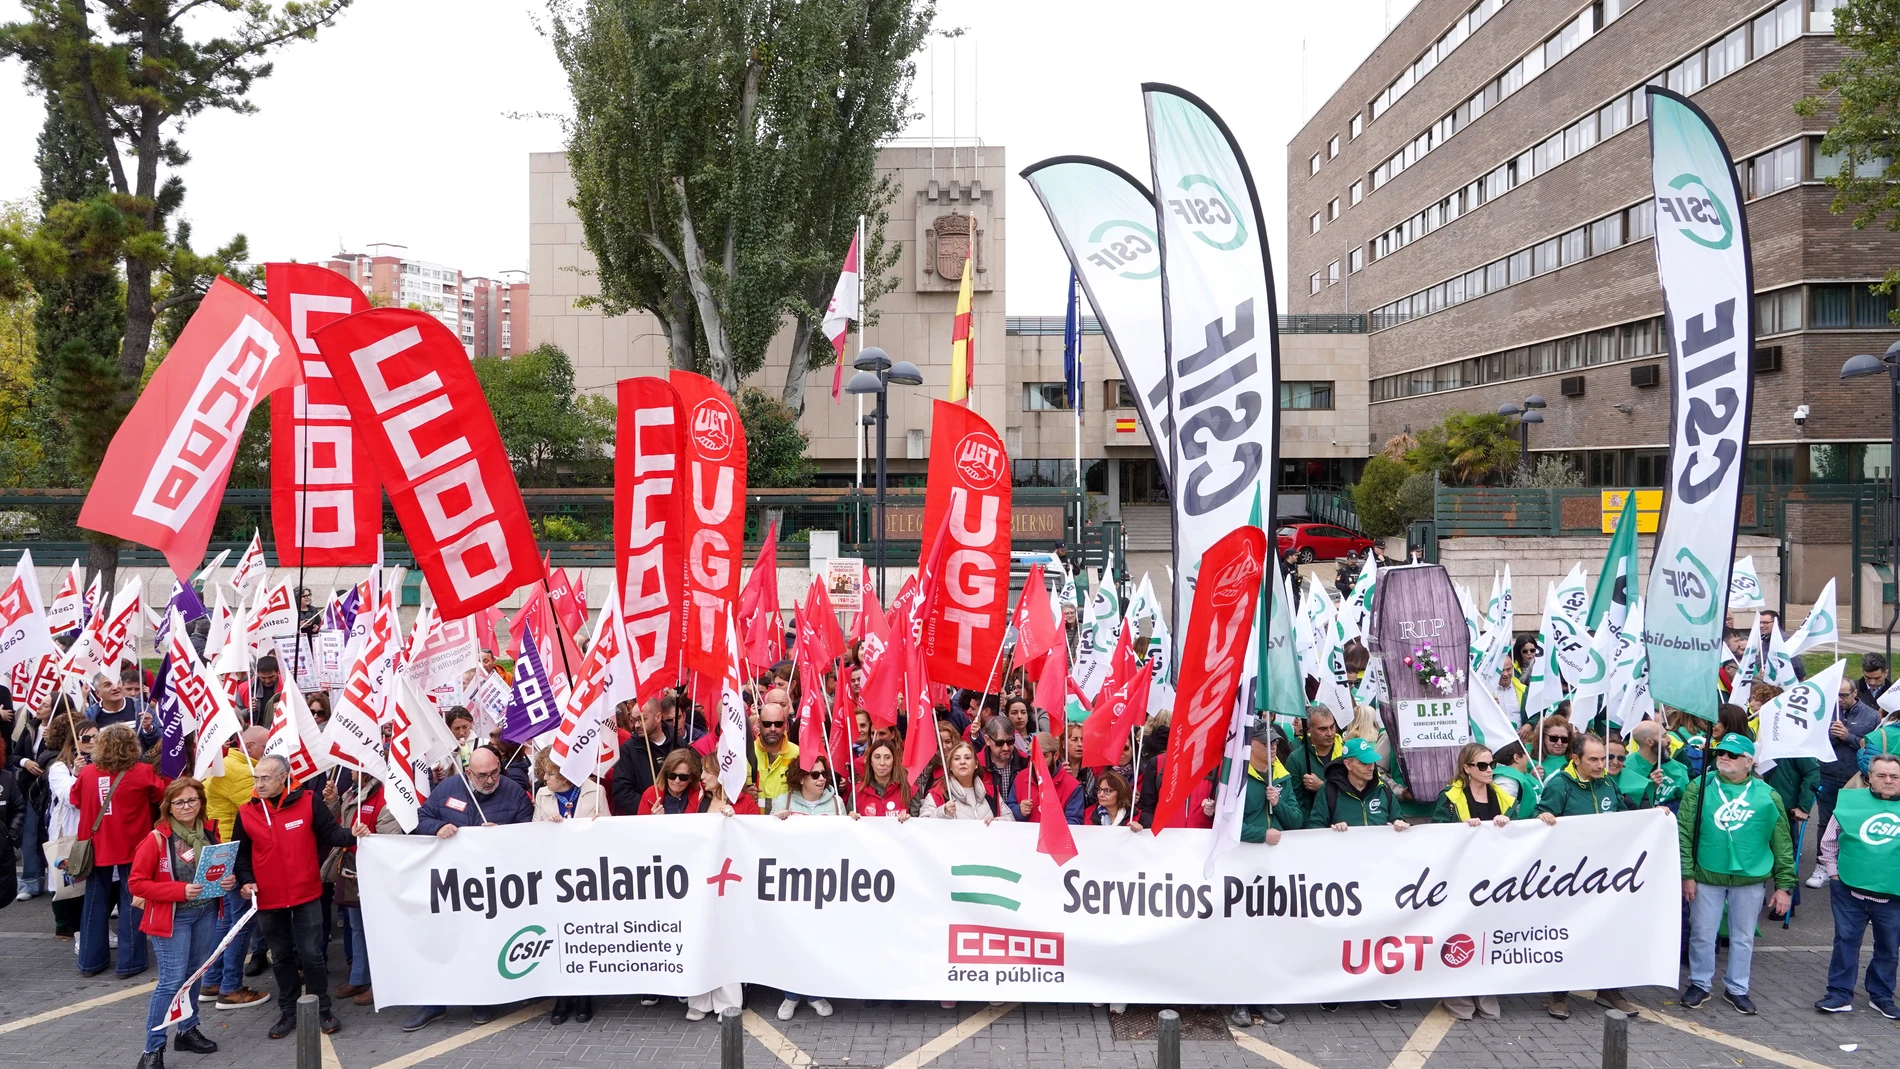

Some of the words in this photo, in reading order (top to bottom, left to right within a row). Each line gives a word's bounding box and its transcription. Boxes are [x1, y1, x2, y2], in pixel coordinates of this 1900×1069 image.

[695, 406, 728, 434] UGT
[350, 325, 513, 602] CCOO
[961, 439, 999, 470] UGT
[623, 406, 675, 685] CCOO
[690, 461, 735, 653] UGT
[943, 487, 999, 667] UGT
[926, 617, 936, 656] Castilla
[1399, 618, 1445, 640] RIP
[1184, 591, 1249, 777] UGT
[1417, 703, 1453, 717] D.E.P.
[1785, 686, 1810, 729] CSIF
[362, 737, 373, 746] y
[394, 778, 416, 806] León
[430, 866, 543, 919] Mejor
[555, 855, 689, 903] salario
[757, 858, 896, 910] Empleo
[1063, 869, 1213, 919] Servicios
[1223, 873, 1362, 918] Públicos
[1395, 867, 1448, 910] de
[1469, 850, 1648, 907] calidad
[564, 921, 618, 935] Central
[623, 920, 682, 934] Sindical
[1492, 925, 1569, 945] Servicios
[508, 939, 554, 962] CSIF
[565, 940, 672, 955] Independiente
[675, 944, 684, 956] y
[957, 932, 1057, 959] CCOO
[1341, 935, 1433, 975] UGT
[1491, 948, 1564, 965] Públicos
[566, 960, 584, 974] de
[589, 959, 684, 974] Funcionarios
[947, 966, 989, 982] área
[995, 966, 1066, 986] pública
